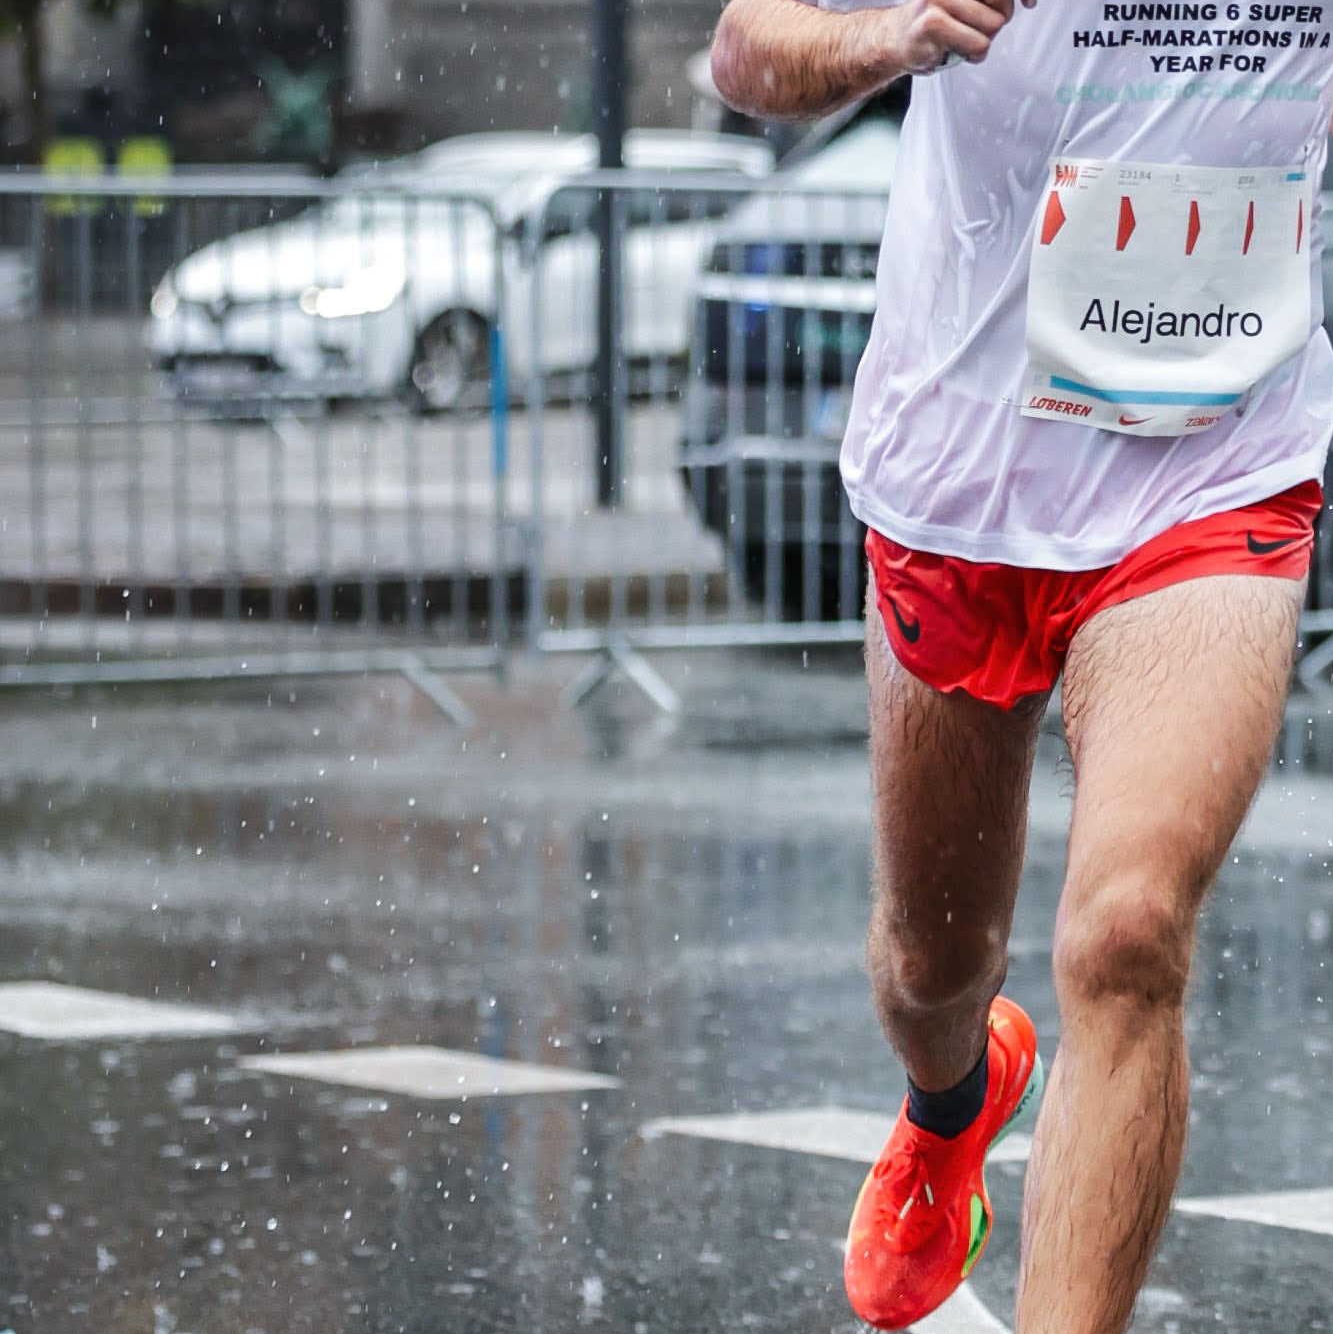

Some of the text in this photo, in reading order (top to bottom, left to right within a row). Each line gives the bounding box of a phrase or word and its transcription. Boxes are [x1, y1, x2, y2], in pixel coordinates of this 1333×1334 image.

[1103, 3, 1324, 24] RUNNING 6 SUPER
[1072, 29, 1332, 50] HALF-MARATHONS IN A
[1149, 53, 1268, 74] YEAR FOR
[1079, 297, 1264, 344] Alejandro
